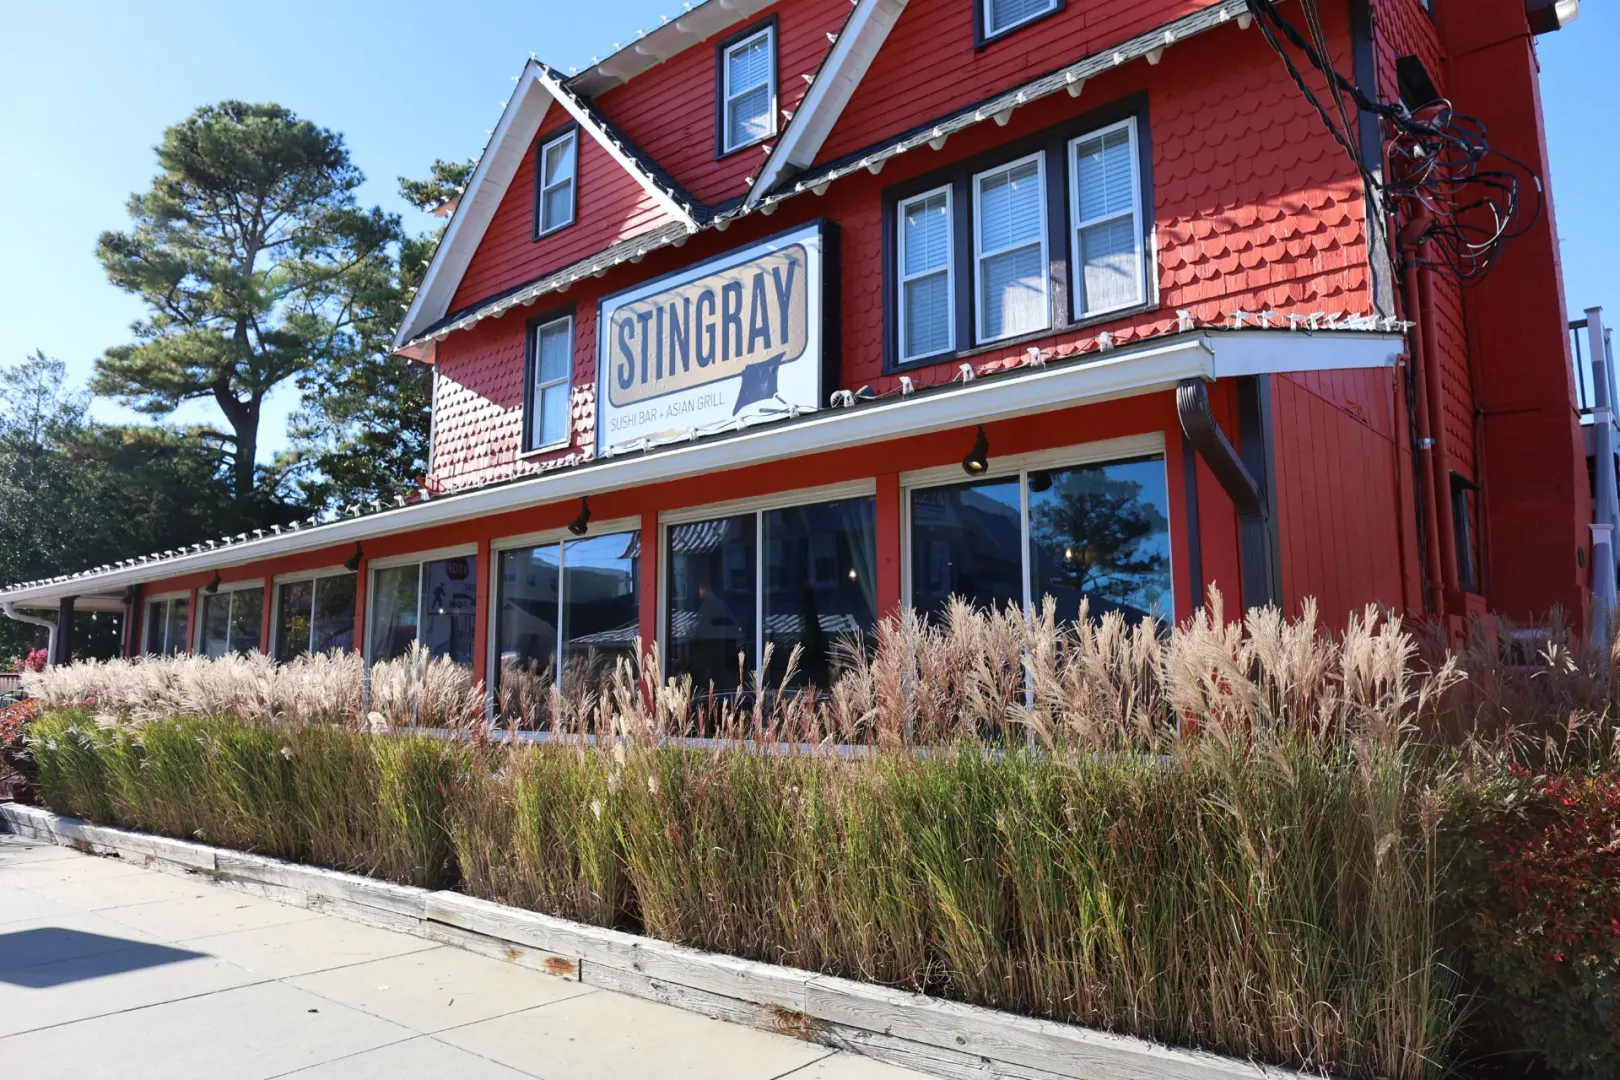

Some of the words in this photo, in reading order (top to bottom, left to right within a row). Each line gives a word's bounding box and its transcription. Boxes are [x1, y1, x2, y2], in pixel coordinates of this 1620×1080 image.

[617, 260, 796, 390] STINGRAY
[610, 413, 637, 432] SUSHI
[638, 408, 658, 425] BAR
[665, 399, 695, 417] ASIAN
[697, 391, 725, 410] GRILL
